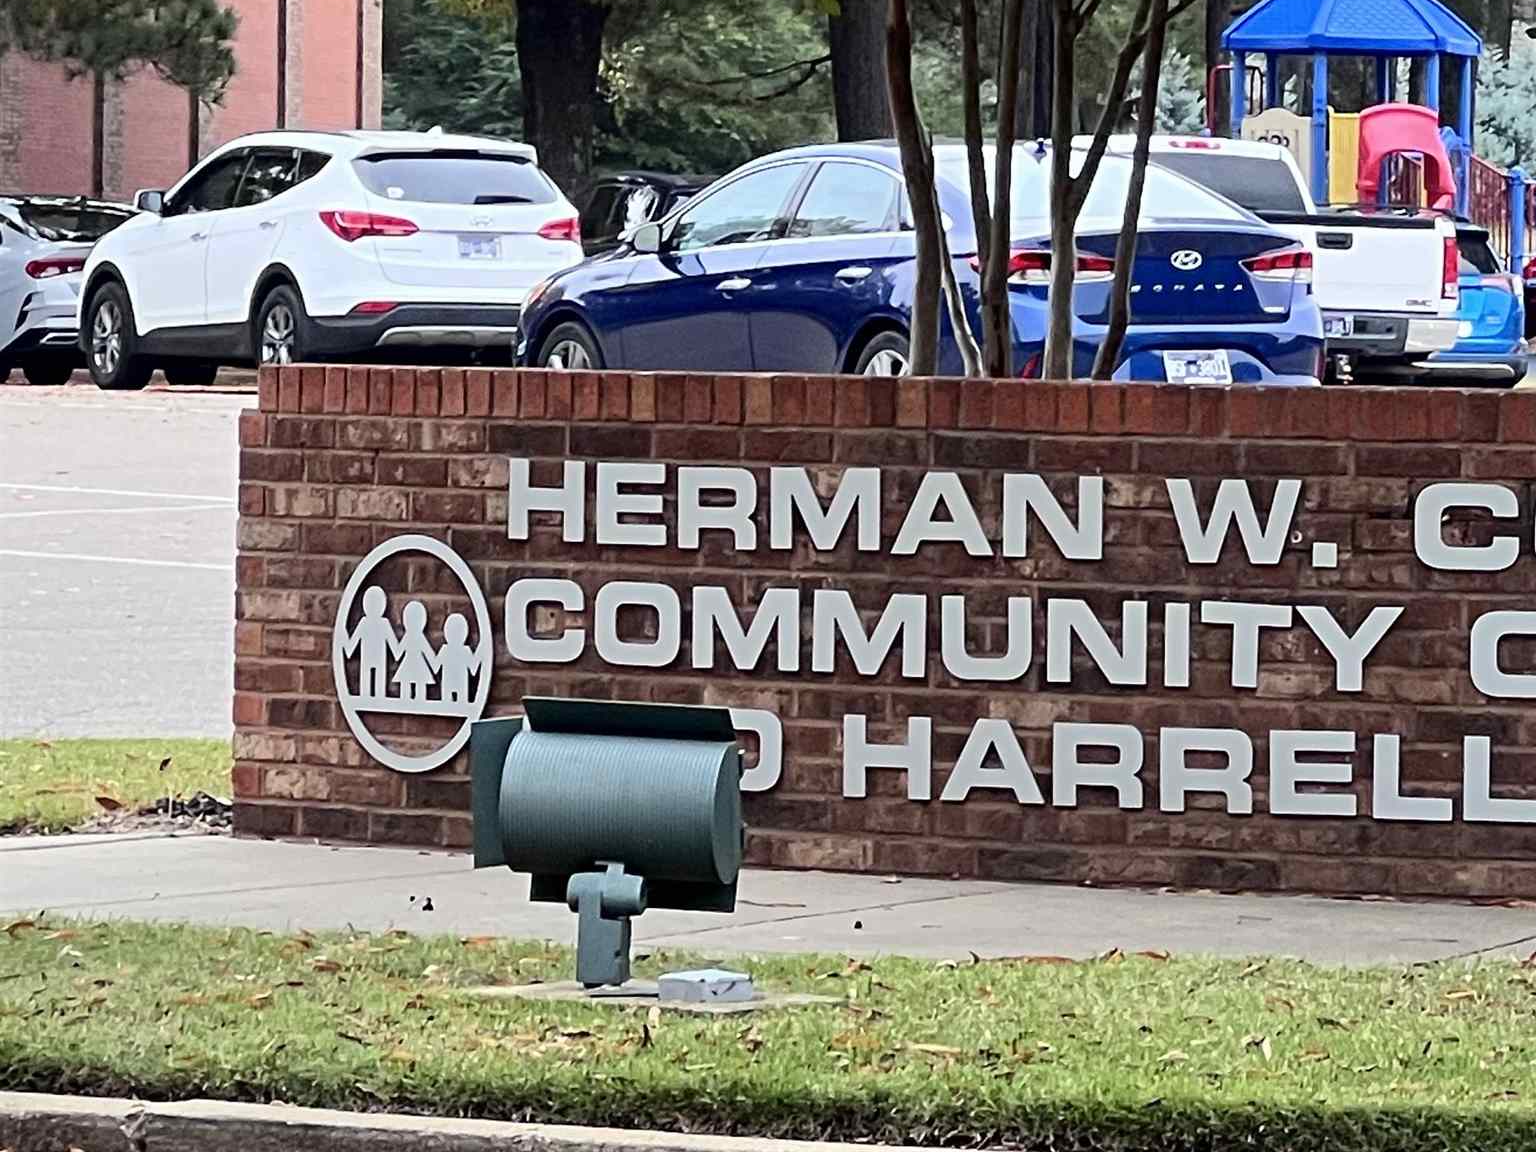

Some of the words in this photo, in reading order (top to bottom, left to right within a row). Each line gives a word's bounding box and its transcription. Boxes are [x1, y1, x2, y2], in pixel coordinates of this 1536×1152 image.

[506, 456, 1104, 561] HERMAN
[1164, 477, 1339, 569] W.
[503, 577, 1406, 693] COMMUNITY
